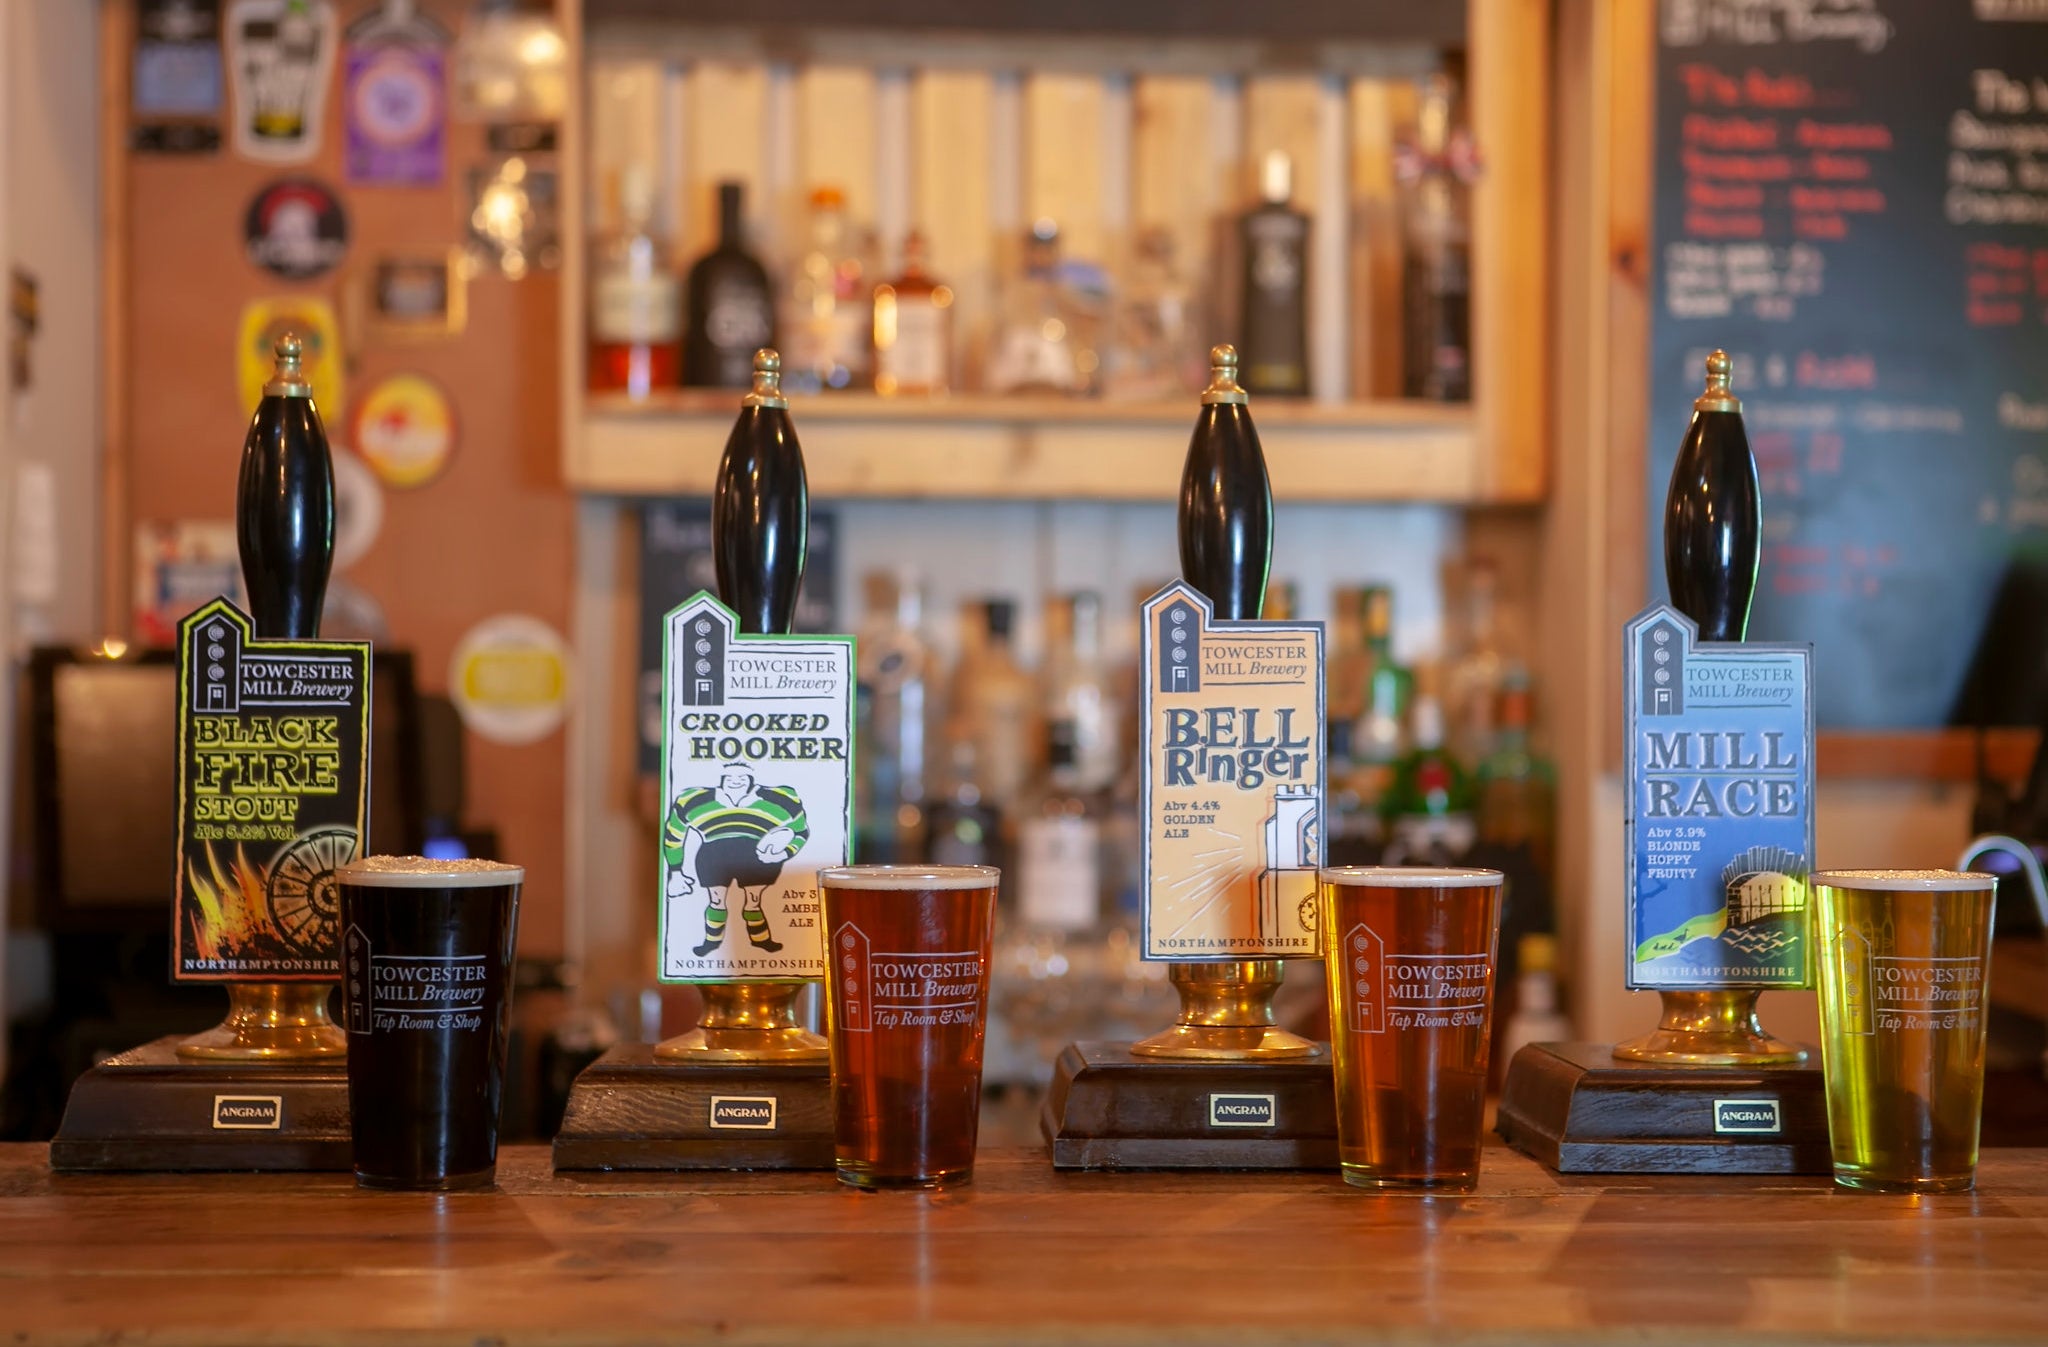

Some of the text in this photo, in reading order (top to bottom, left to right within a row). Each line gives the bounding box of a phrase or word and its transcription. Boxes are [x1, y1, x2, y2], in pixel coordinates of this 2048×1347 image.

[1202, 646, 1307, 659] TOWCESTER
[240, 664, 354, 680] TOWCESTER
[728, 659, 837, 673] TOWCESTER
[1205, 663, 1307, 679] MILL Brewery
[1686, 668, 1794, 682] TOWCESTER
[243, 680, 353, 700] MILL Brewery
[730, 675, 837, 693] MILL Brewery
[1689, 684, 1794, 701] MILL Brewery
[680, 713, 829, 734] CROOKED
[1163, 707, 1310, 750] BELL
[194, 716, 339, 749] BLACK
[689, 737, 846, 762] HOOKER
[1644, 732, 1797, 771] MILL
[194, 751, 340, 794] FIRE
[1163, 801, 1221, 811] Abv 4.4%
[1644, 779, 1798, 818] RACE
[194, 795, 299, 822] STOUT
[1163, 815, 1216, 825] GOLDEN
[1163, 829, 1190, 838] ALE
[1647, 827, 1706, 838] Abv 3.9%
[1647, 841, 1701, 852] BLONDE
[1647, 855, 1692, 866] HOPPY
[1647, 868, 1697, 879] FRUITY
[783, 889, 806, 899] Abv
[782, 904, 821, 913] AMBE
[789, 919, 814, 928] ALE
[1158, 938, 1309, 948] NORTHAMPTONSHIRE
[184, 958, 340, 970] NORTHAMPTONSHIR
[675, 959, 824, 970] NORTHAMPTONSHIR
[872, 962, 980, 979] TOWCESTER
[1640, 966, 1796, 977] NORTHAMPTONSHIRE
[372, 965, 487, 983] TOWCESTER
[1385, 964, 1488, 981] TOWCESTER
[1873, 966, 1981, 984] TOWCESTER
[374, 984, 486, 1005] MILL Brewery
[875, 980, 978, 1000] MILL Brewery
[1388, 982, 1486, 1002] MILL Brewery
[1877, 985, 1925, 1001] MILL
[374, 1013, 483, 1033] Tap Room & Shop
[874, 1010, 898, 1030] Tap
[900, 1010, 936, 1026] Room
[938, 1010, 954, 1025] &
[1388, 1012, 1412, 1031] Tap
[1413, 1012, 1449, 1028] Room
[1450, 1011, 1465, 1027] &
[1878, 1013, 1902, 1033] Tap
[1942, 1014, 1957, 1030] &
[219, 1106, 276, 1118] ANGRAM
[716, 1106, 771, 1118] ANGRAM
[1216, 1105, 1270, 1116] ANGRAM
[1721, 1110, 1775, 1122] ANGRAM
